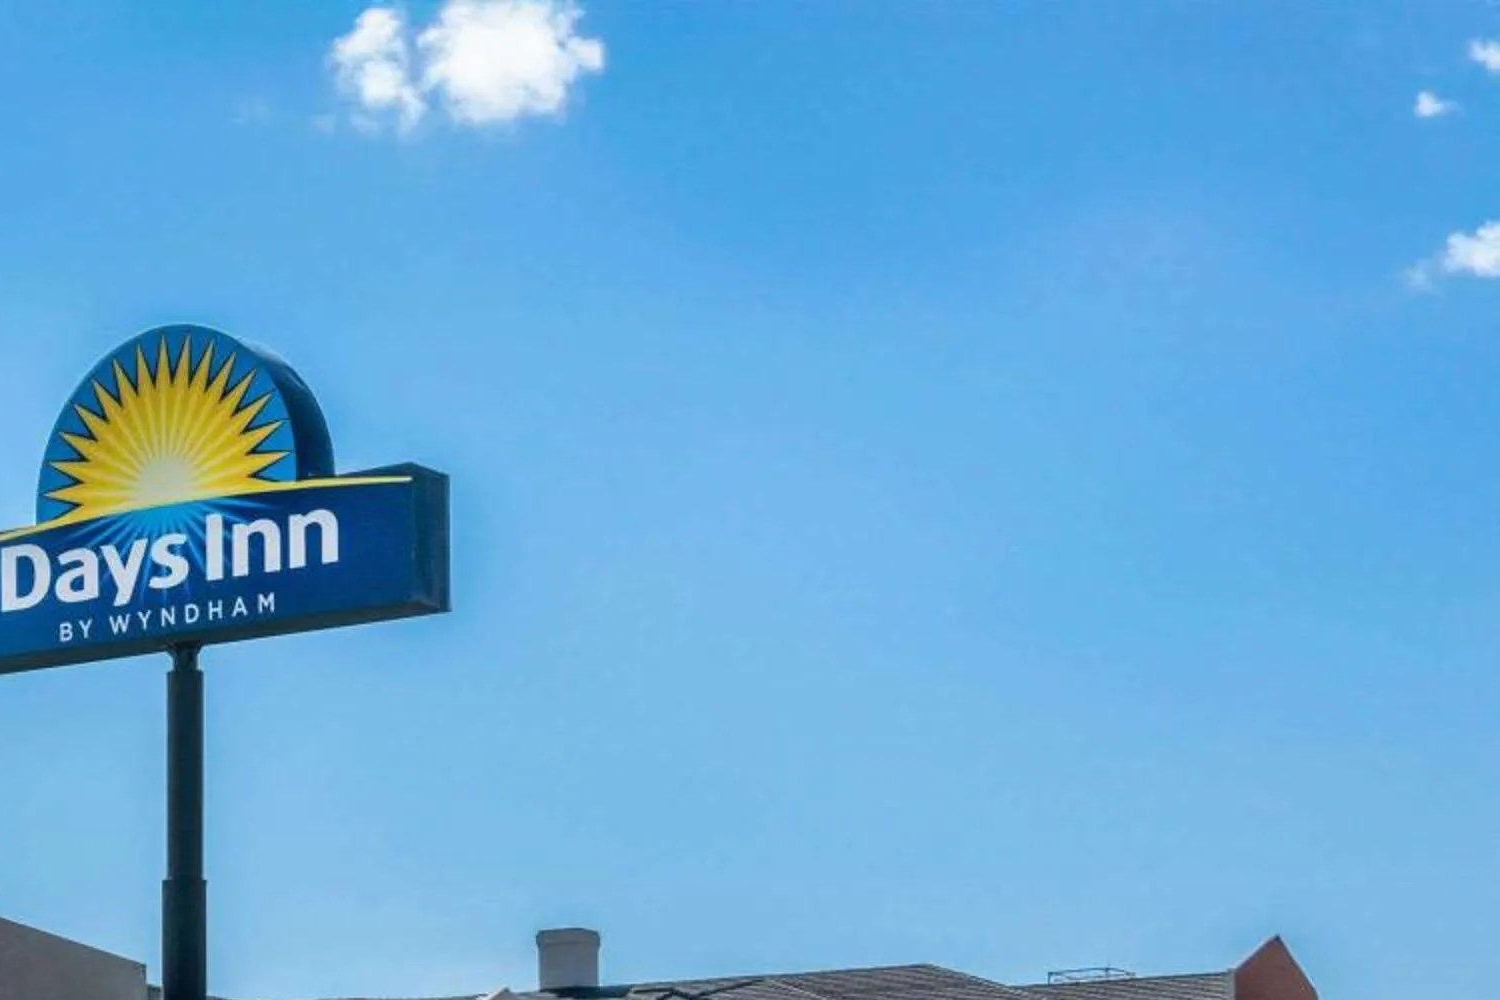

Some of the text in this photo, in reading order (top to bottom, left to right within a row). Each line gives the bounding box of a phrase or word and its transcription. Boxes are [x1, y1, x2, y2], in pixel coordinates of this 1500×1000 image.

[0, 509, 339, 612] Days Inn
[59, 593, 276, 642] BY WYNDHAM
